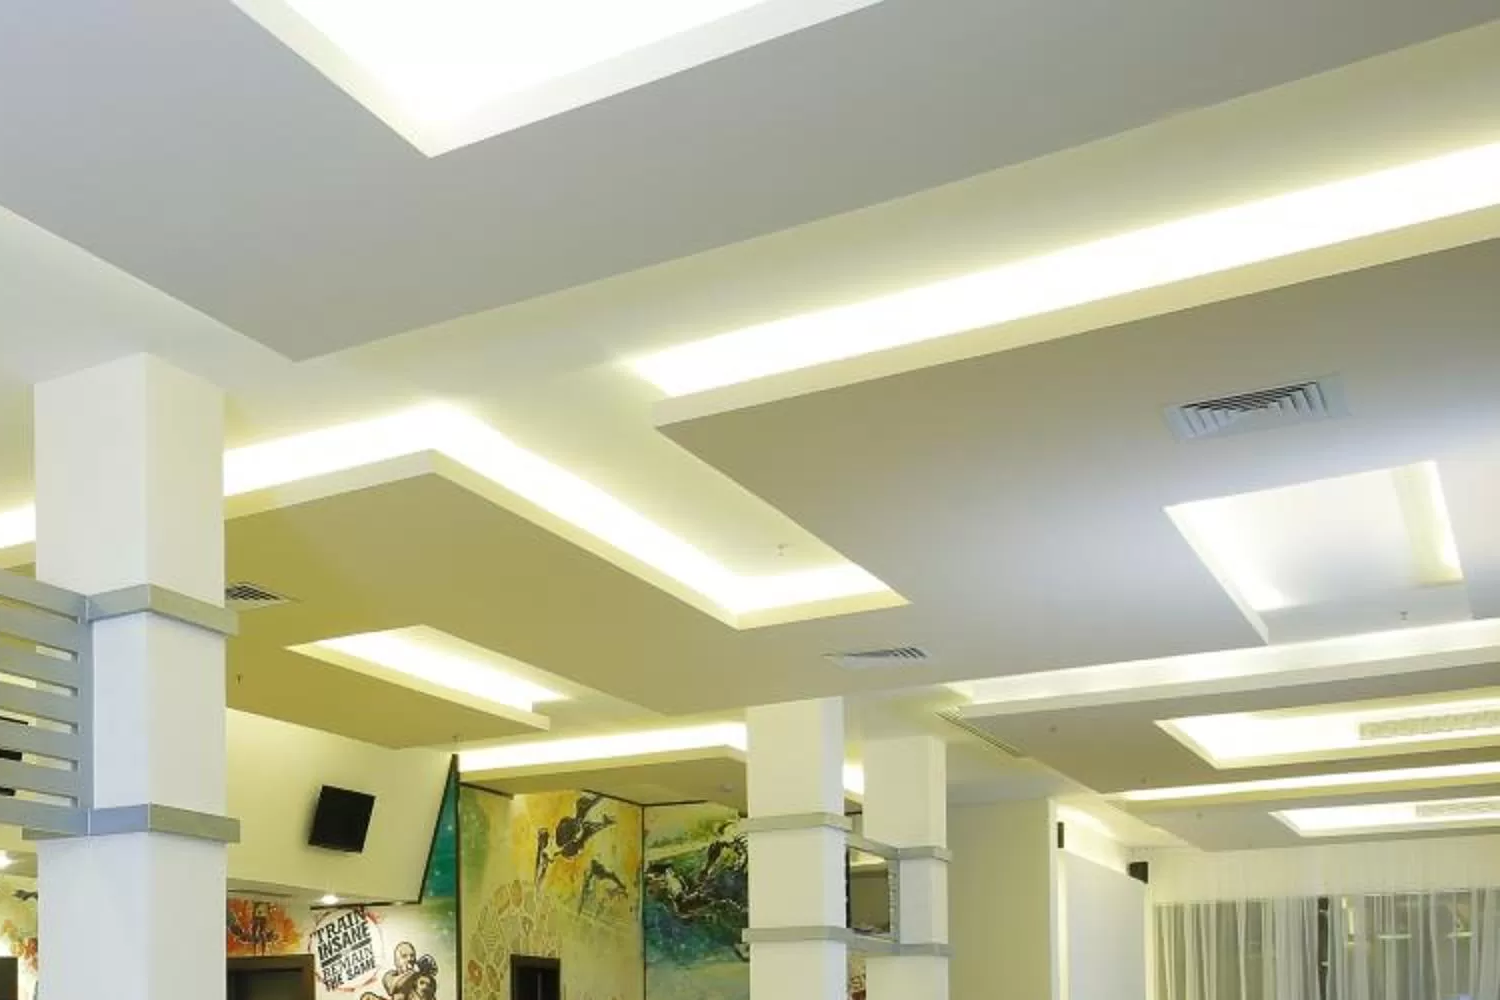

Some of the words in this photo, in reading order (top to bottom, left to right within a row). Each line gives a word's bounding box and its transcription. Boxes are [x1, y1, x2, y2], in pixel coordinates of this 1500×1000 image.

[316, 905, 368, 944] TRAIN
[316, 923, 371, 961] INSANE
[322, 944, 376, 982] REMAIN
